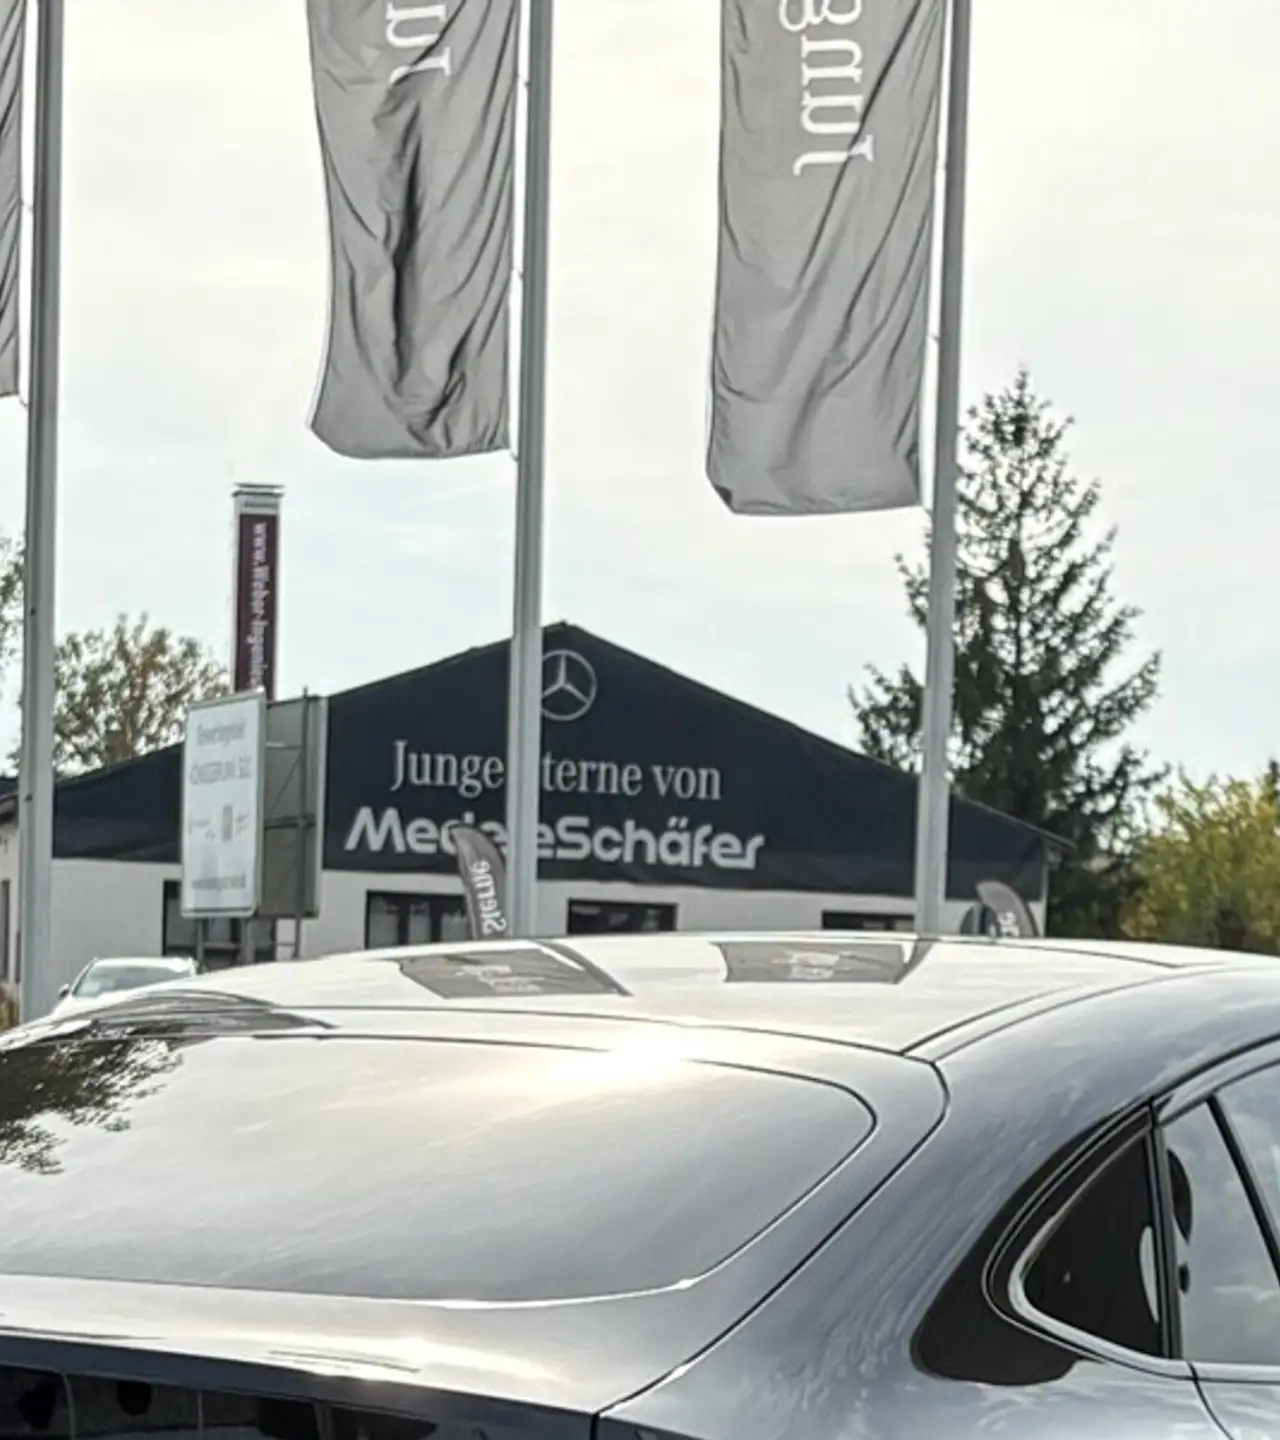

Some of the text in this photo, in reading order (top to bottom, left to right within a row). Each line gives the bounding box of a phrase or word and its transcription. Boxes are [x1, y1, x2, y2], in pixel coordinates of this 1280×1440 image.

[390, 739, 722, 801] Junge terne von
